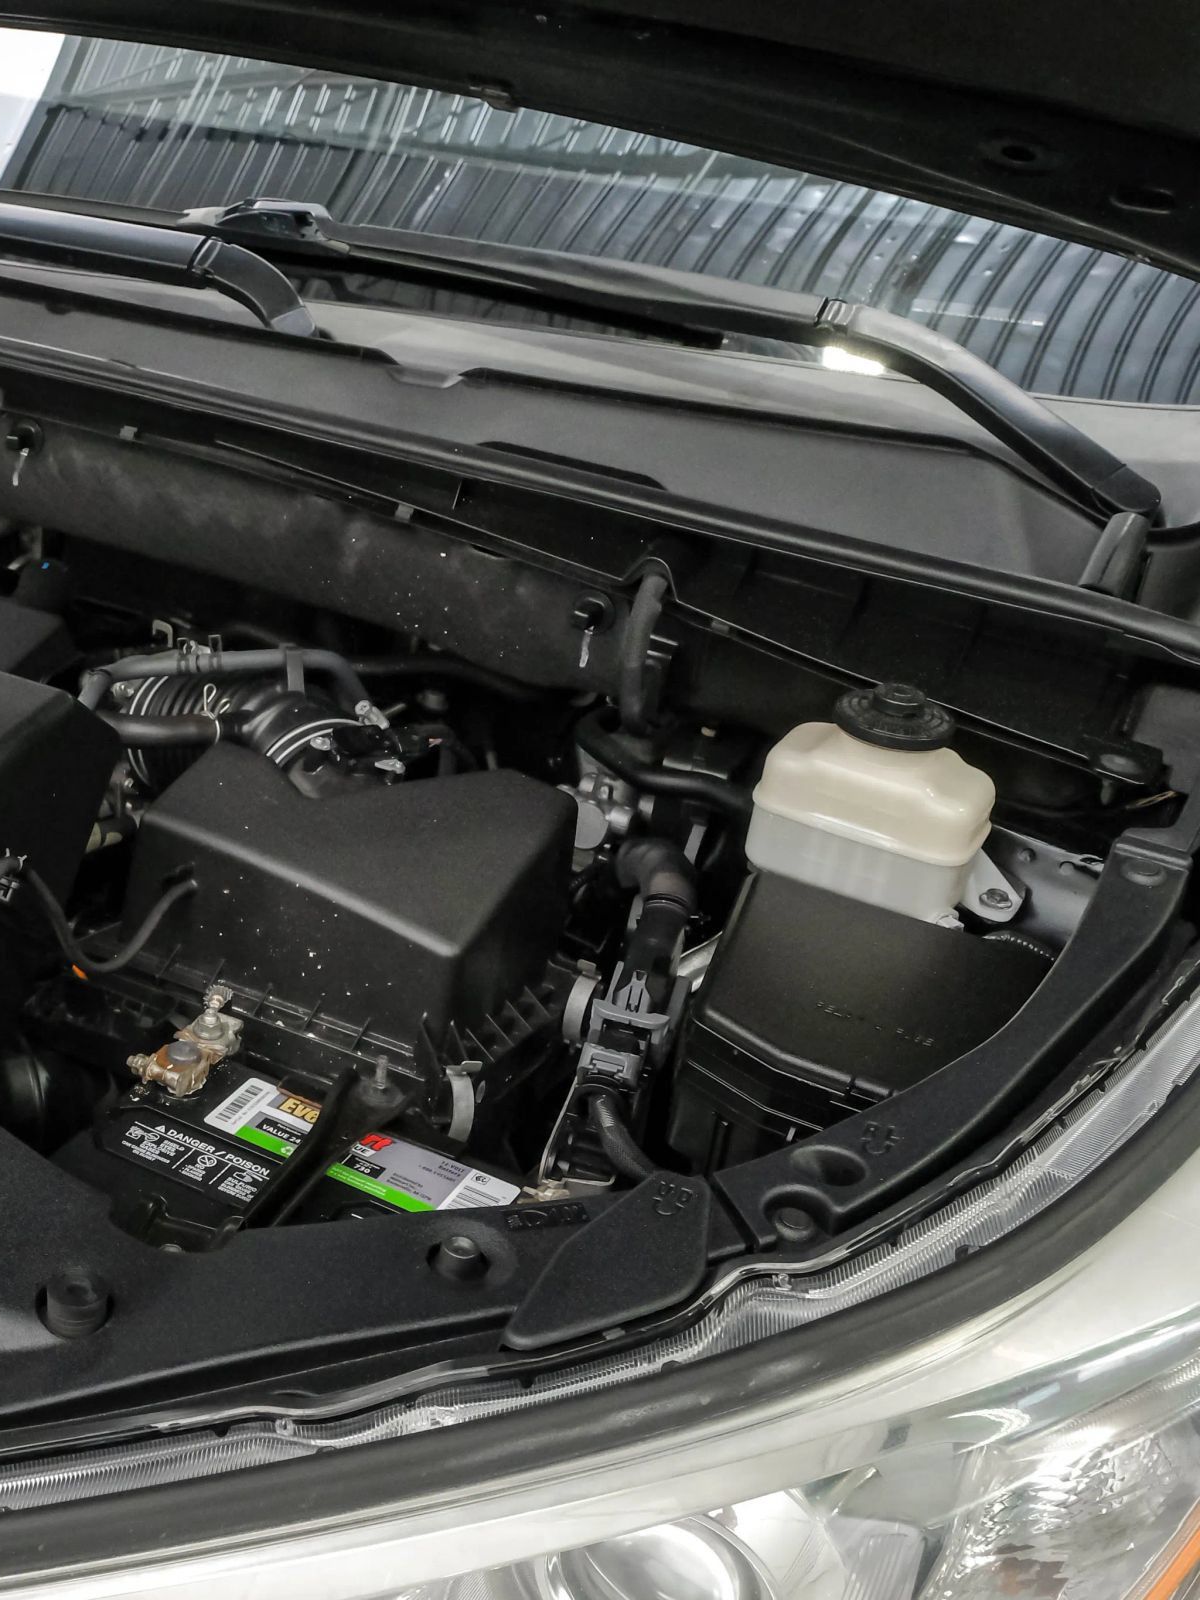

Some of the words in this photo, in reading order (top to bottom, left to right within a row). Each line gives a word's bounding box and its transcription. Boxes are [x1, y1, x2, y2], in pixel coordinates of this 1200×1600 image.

[262, 1123, 290, 1140] VALUE
[166, 1129, 216, 1154] DANGER
[224, 1152, 270, 1176] POISON
[352, 1163, 372, 1174] 730
